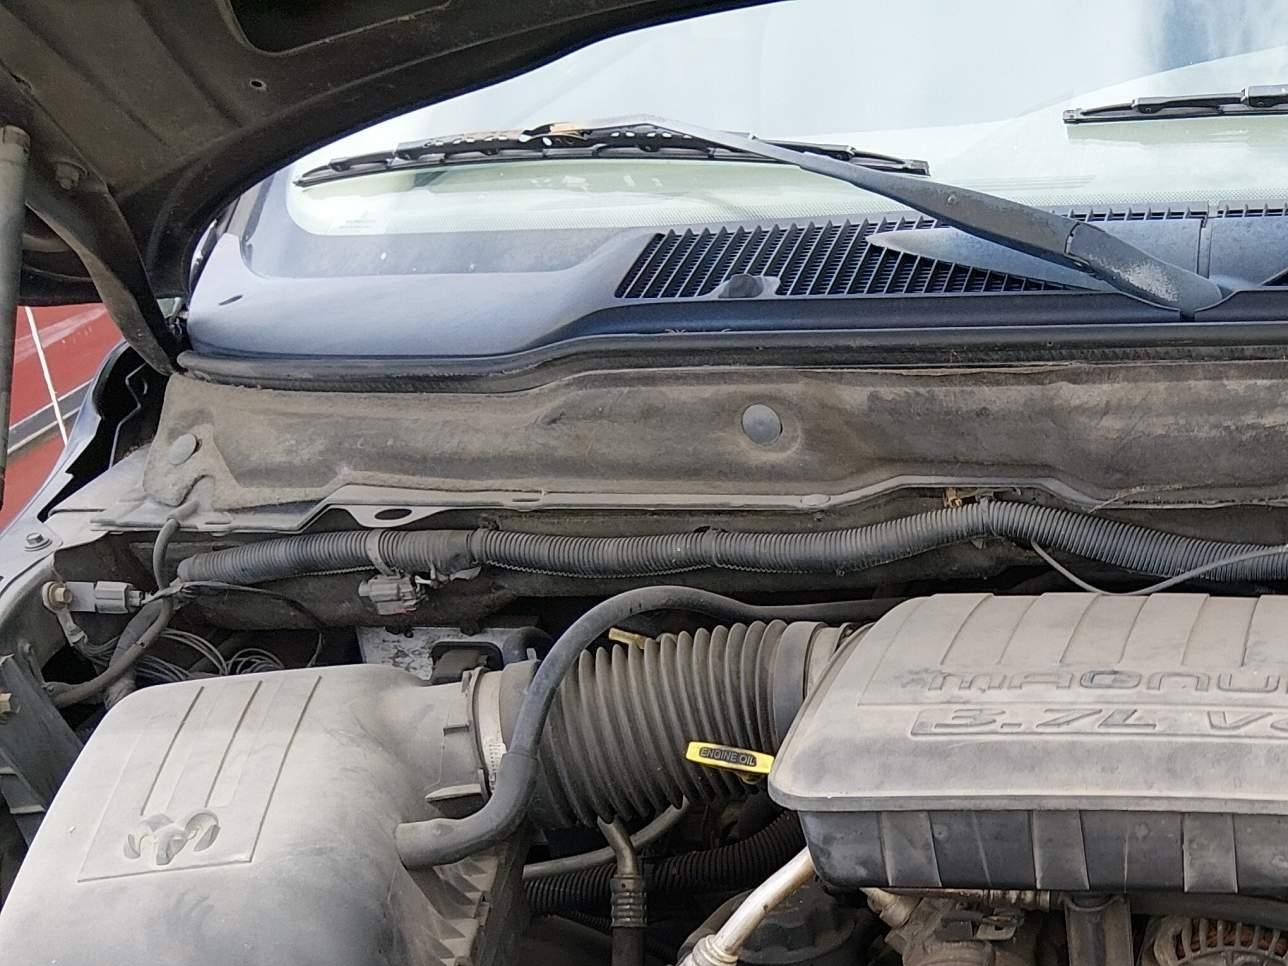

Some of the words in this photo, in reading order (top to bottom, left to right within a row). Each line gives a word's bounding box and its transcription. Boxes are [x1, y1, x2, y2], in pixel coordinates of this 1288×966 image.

[934, 707, 1157, 729] 3.7L
[700, 747, 738, 763] ENGINE
[739, 753, 756, 767] OIL
